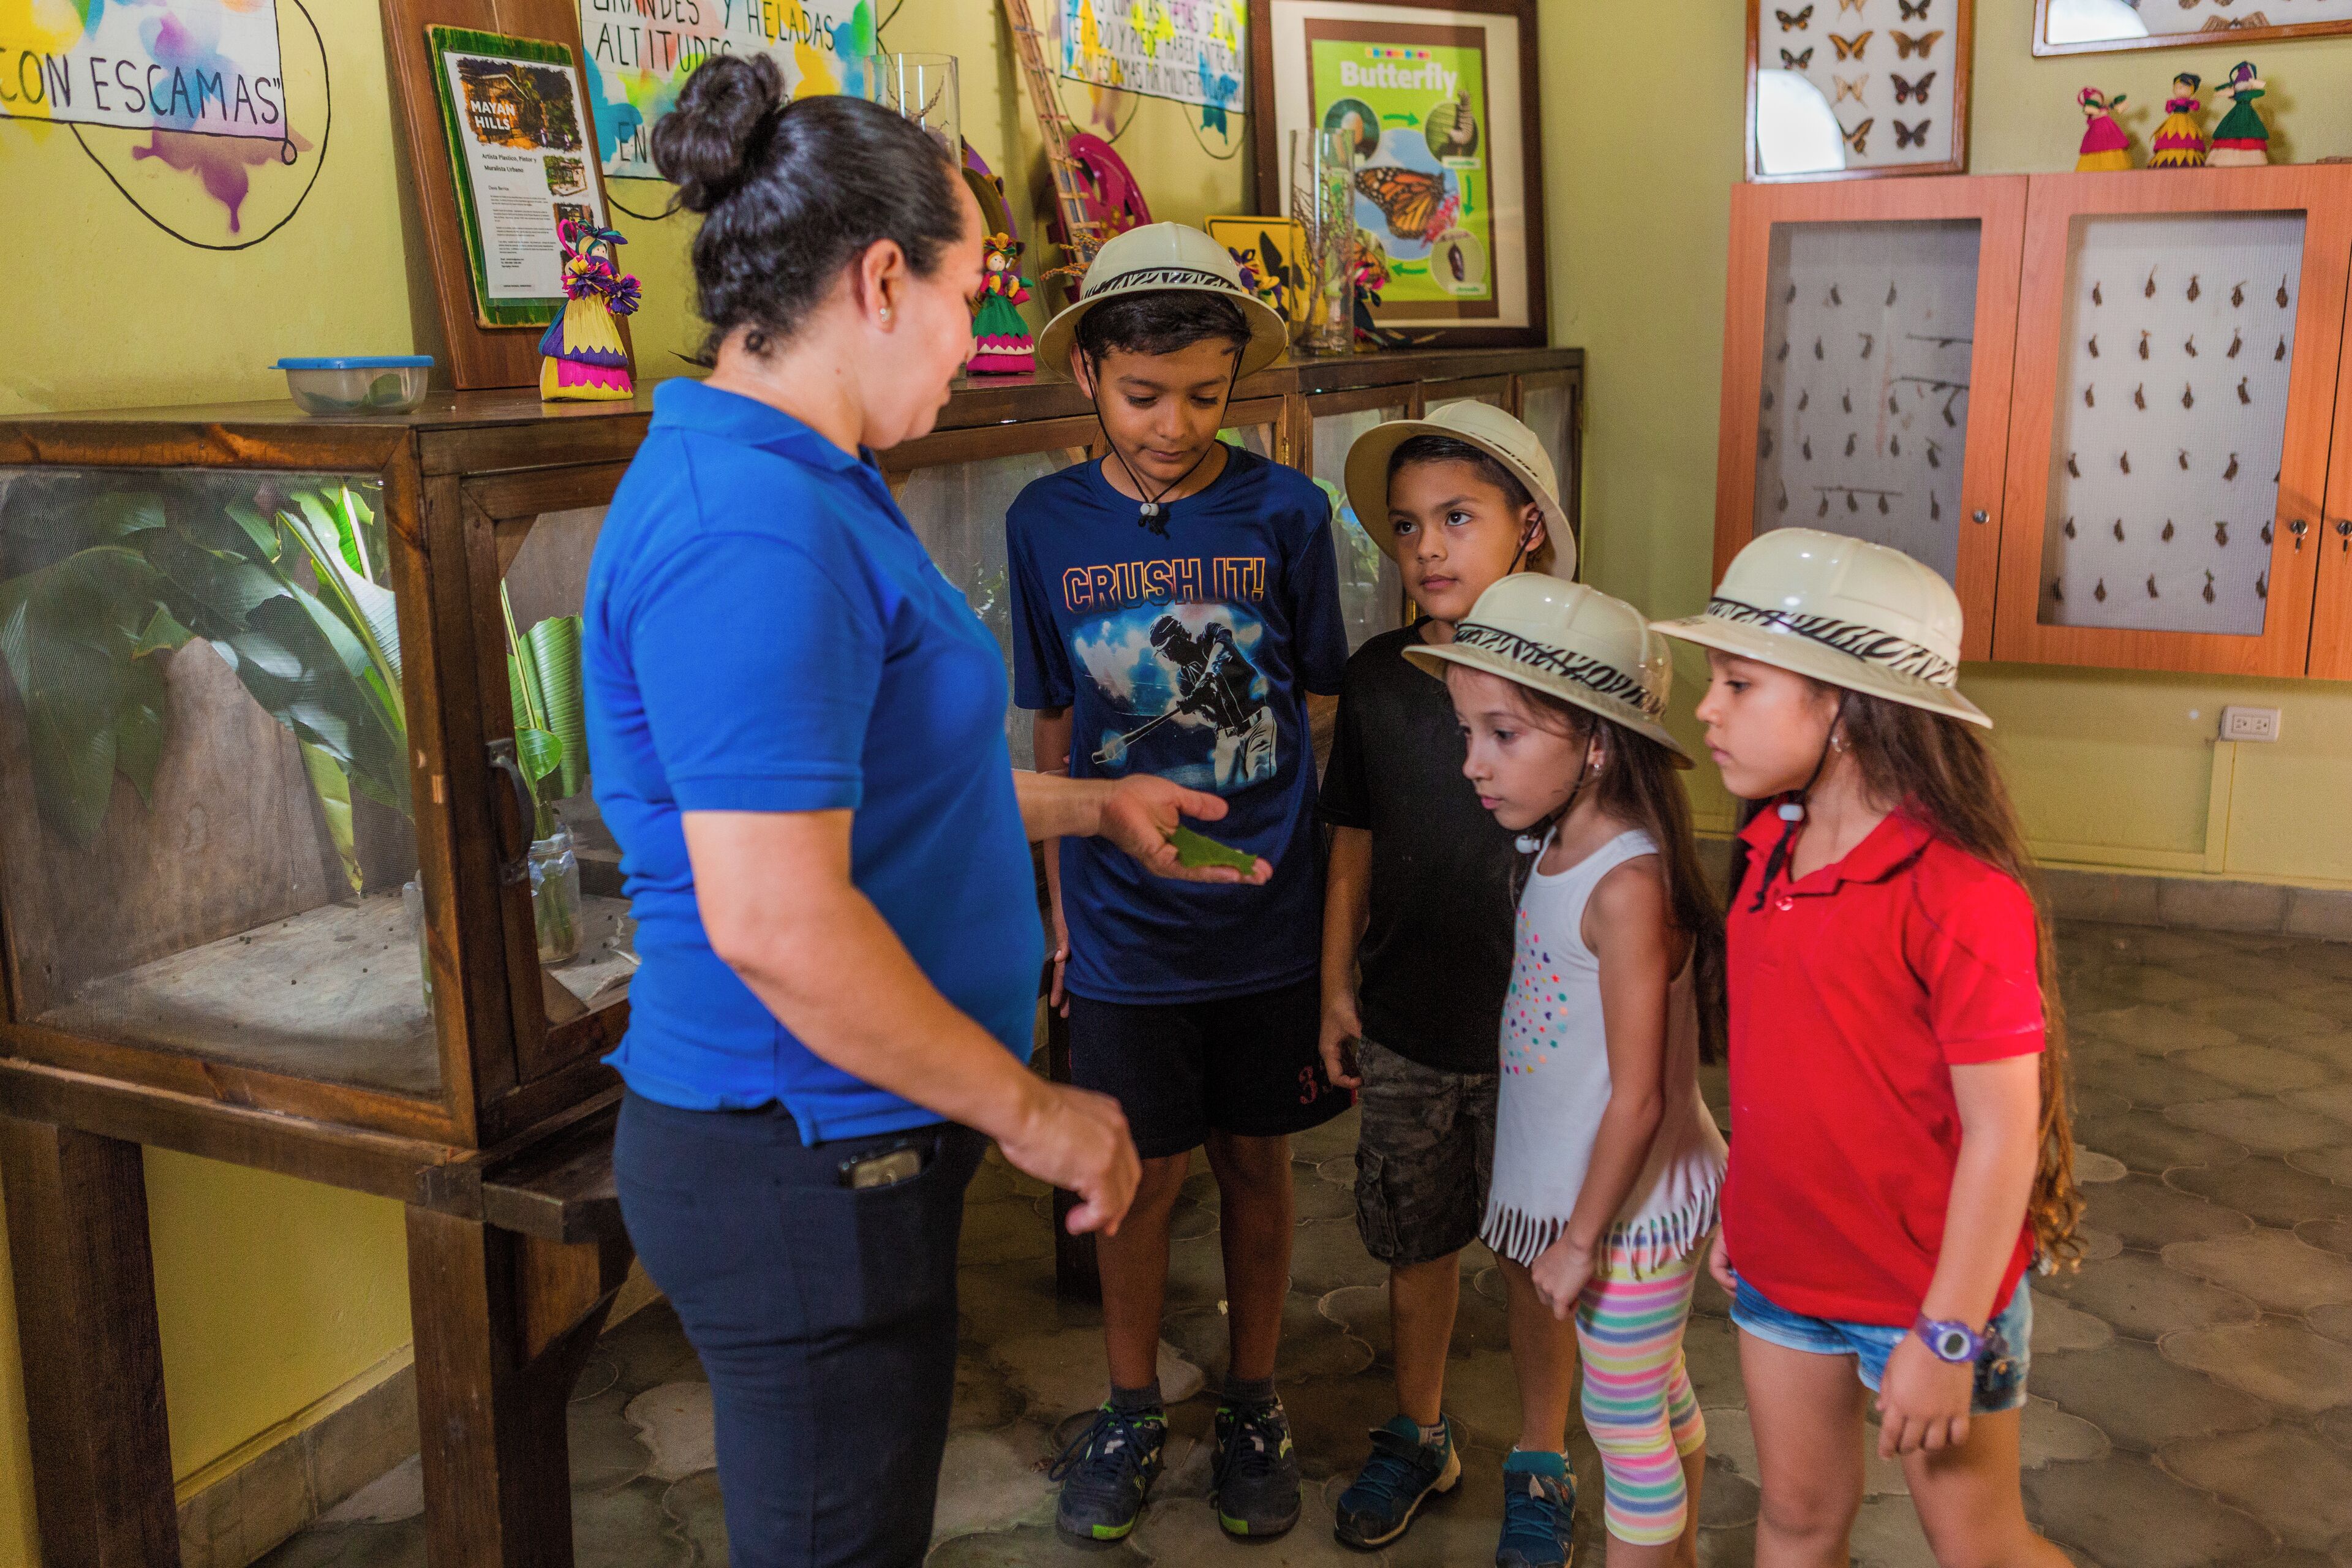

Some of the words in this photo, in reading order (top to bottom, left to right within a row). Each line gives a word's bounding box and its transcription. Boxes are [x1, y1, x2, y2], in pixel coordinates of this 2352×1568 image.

[594, 0, 699, 25] ANDES
[746, 0, 835, 51] HELADAS
[1340, 60, 1458, 99] Butterfly
[470, 100, 516, 116] MAYAN
[474, 115, 511, 130] HILLS
[618, 121, 647, 164] EN
[1062, 557, 1204, 615] CRUSH
[1213, 557, 1265, 603] IT!
